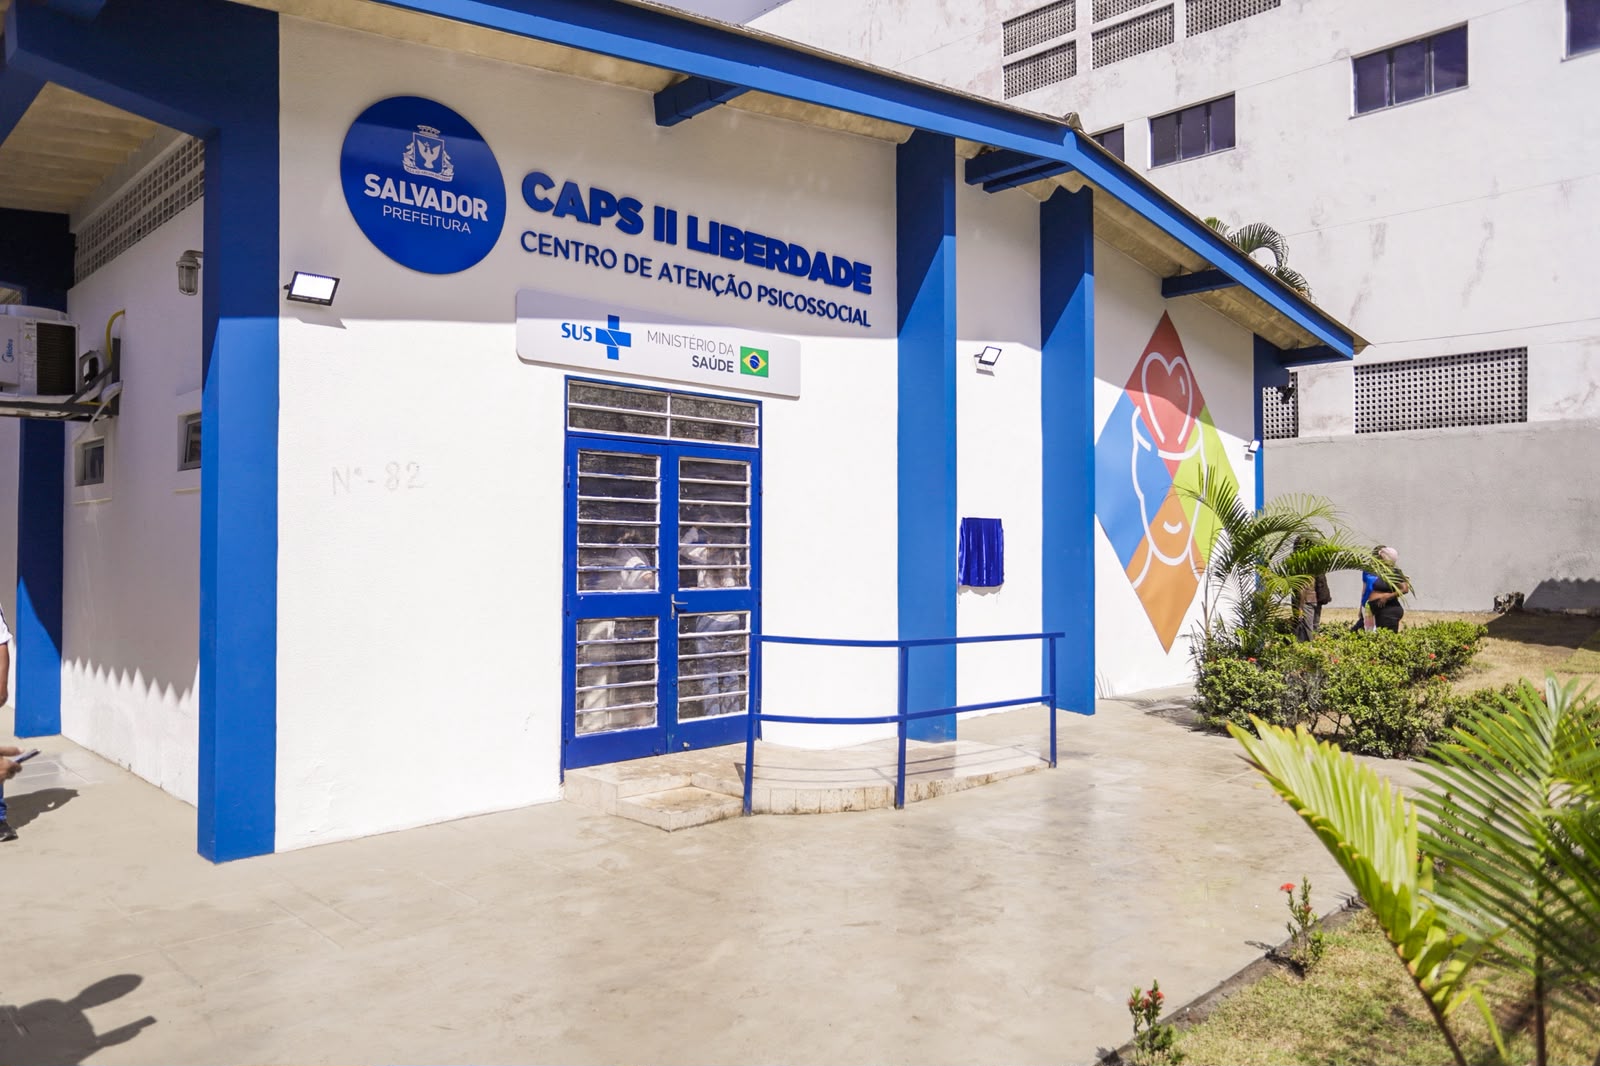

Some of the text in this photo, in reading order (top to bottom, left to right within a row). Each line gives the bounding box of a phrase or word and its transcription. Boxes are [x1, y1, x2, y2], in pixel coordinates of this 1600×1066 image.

[364, 174, 488, 221] SALVADOR
[383, 205, 471, 234] PREFEITURA
[521, 171, 872, 294] CAPS II LIBERDADE
[520, 230, 872, 327] CENTRO DE ATENÇÃO PSICOSSOCIAL
[561, 323, 592, 342] SUS
[647, 330, 734, 356] MINISTÉRIO DA
[692, 354, 734, 373] SAÚDE
